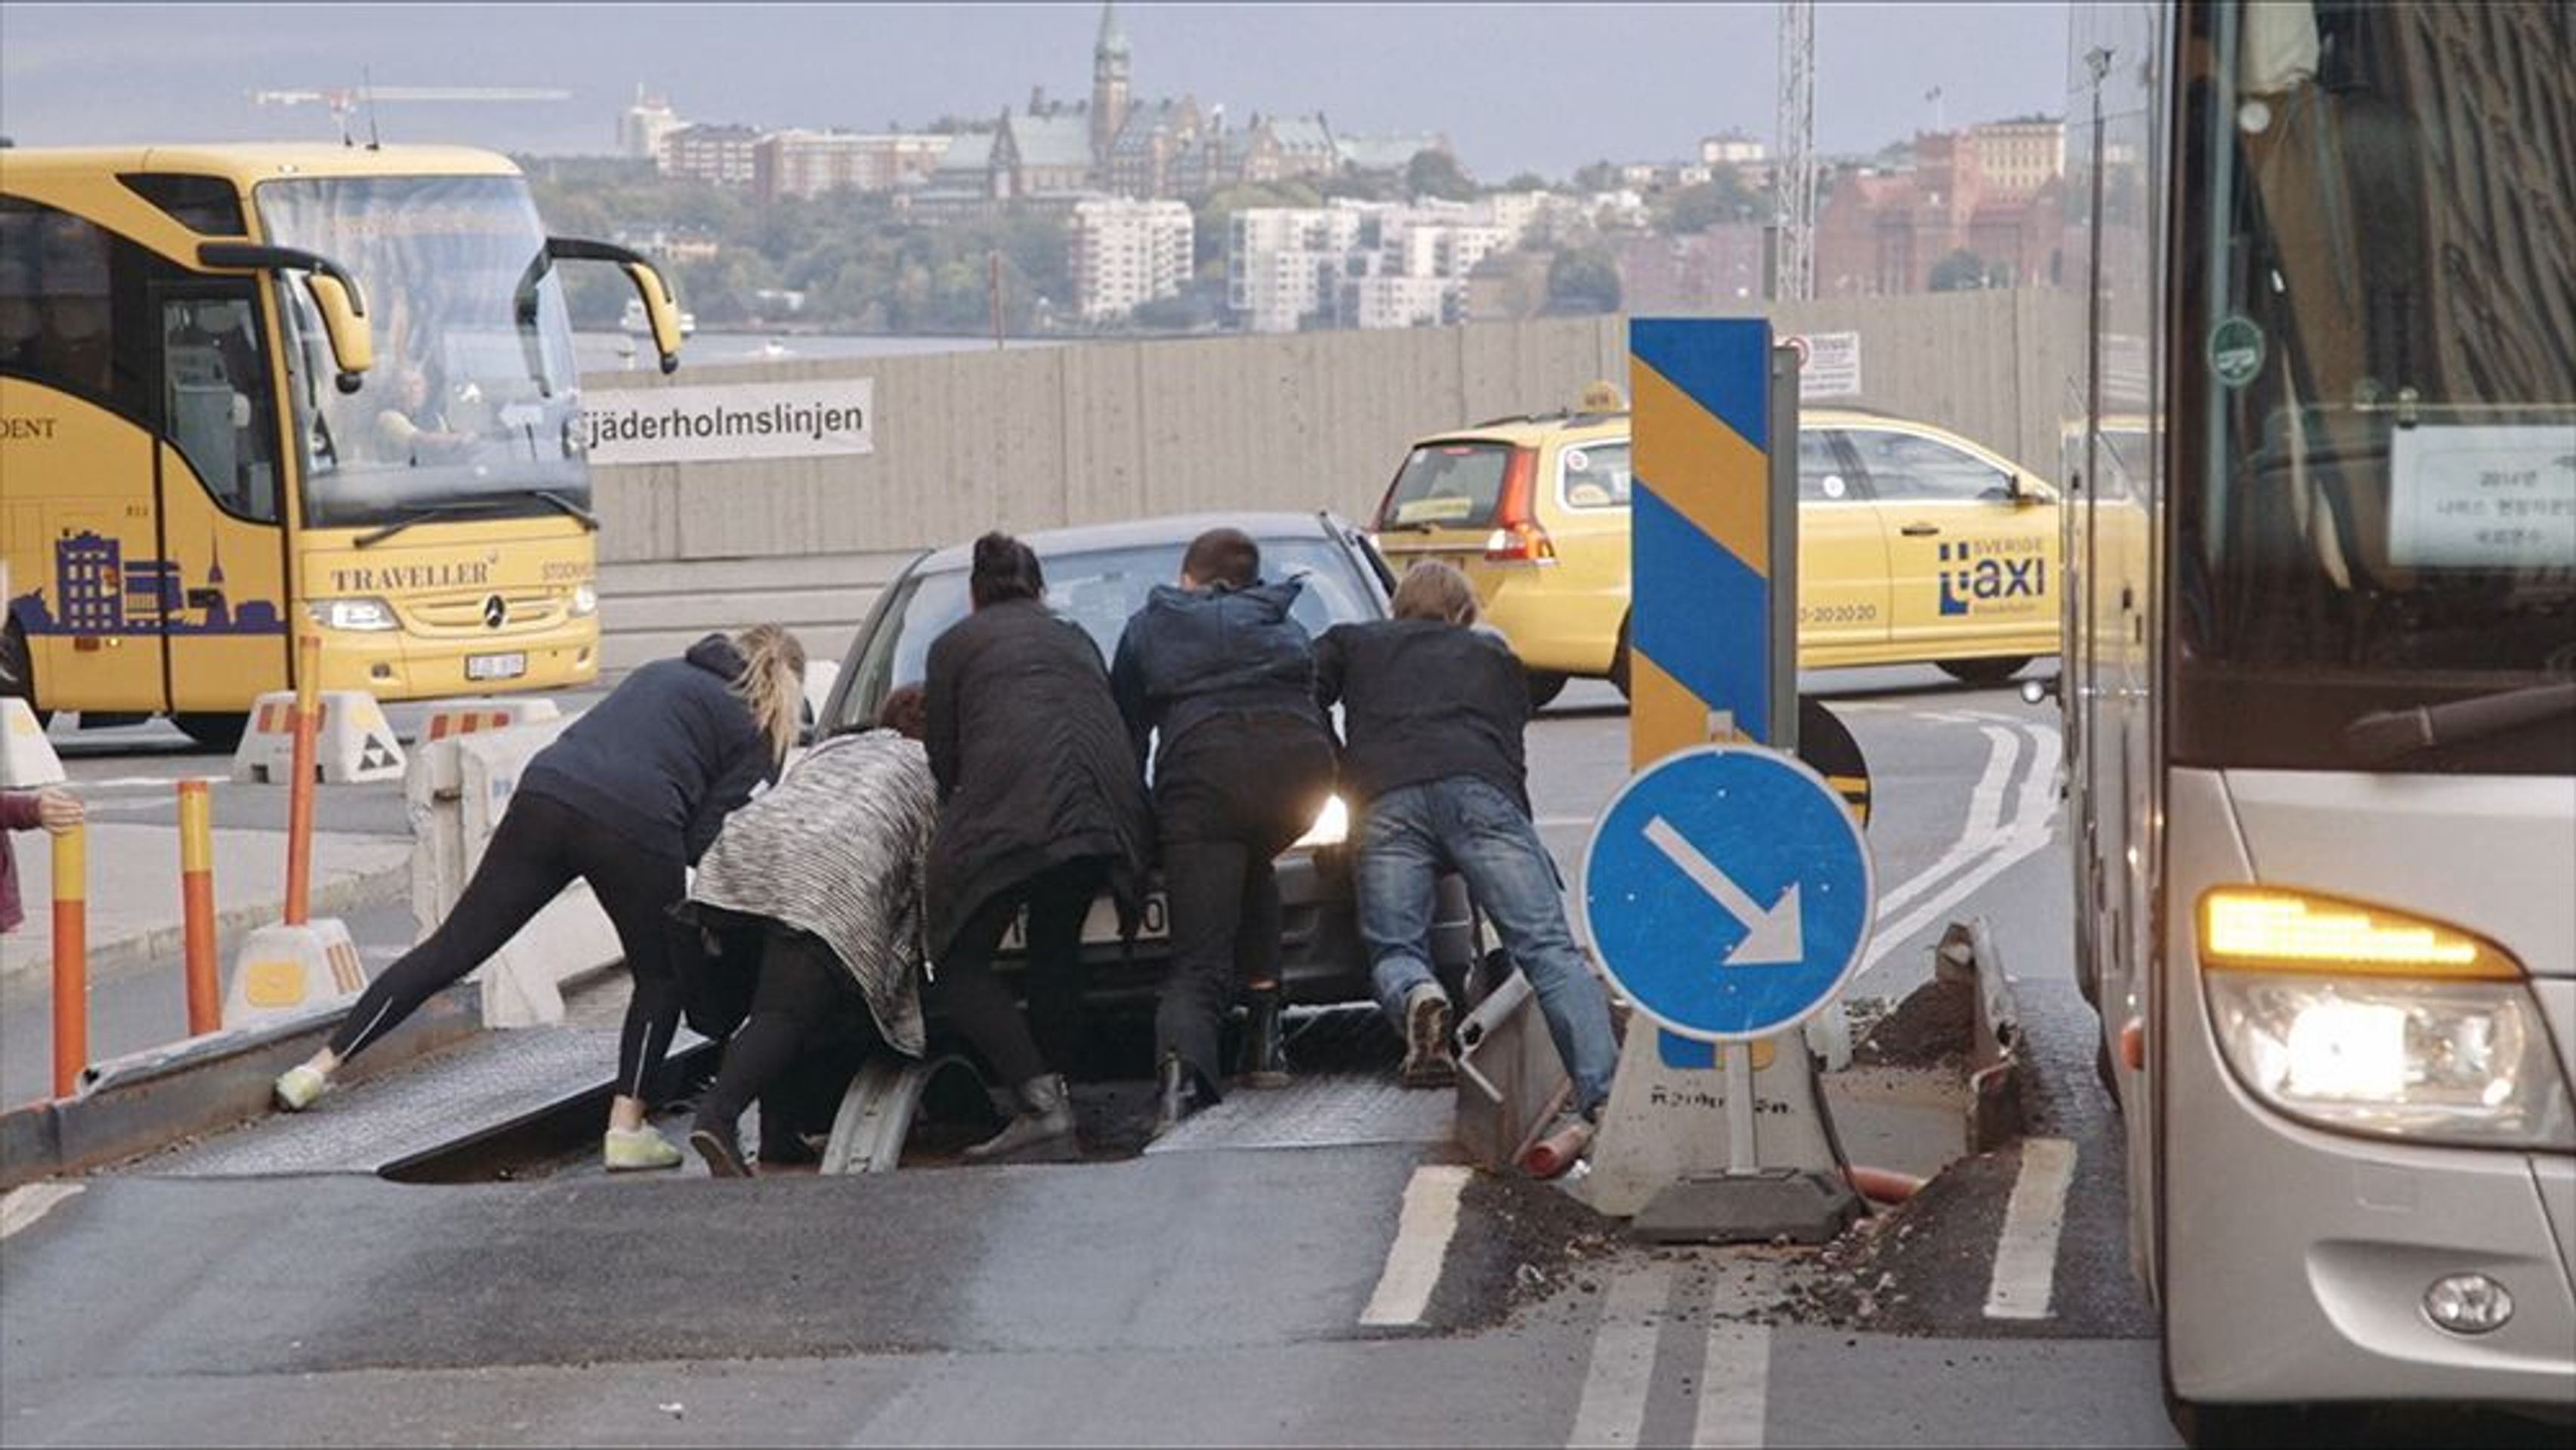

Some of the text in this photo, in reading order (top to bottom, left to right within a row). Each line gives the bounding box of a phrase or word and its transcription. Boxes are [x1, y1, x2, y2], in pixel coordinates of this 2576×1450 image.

[581, 402, 863, 449] jäderholmslinjen
[1973, 537, 2043, 553] SVERIGE
[331, 564, 488, 591] TRAVELLER
